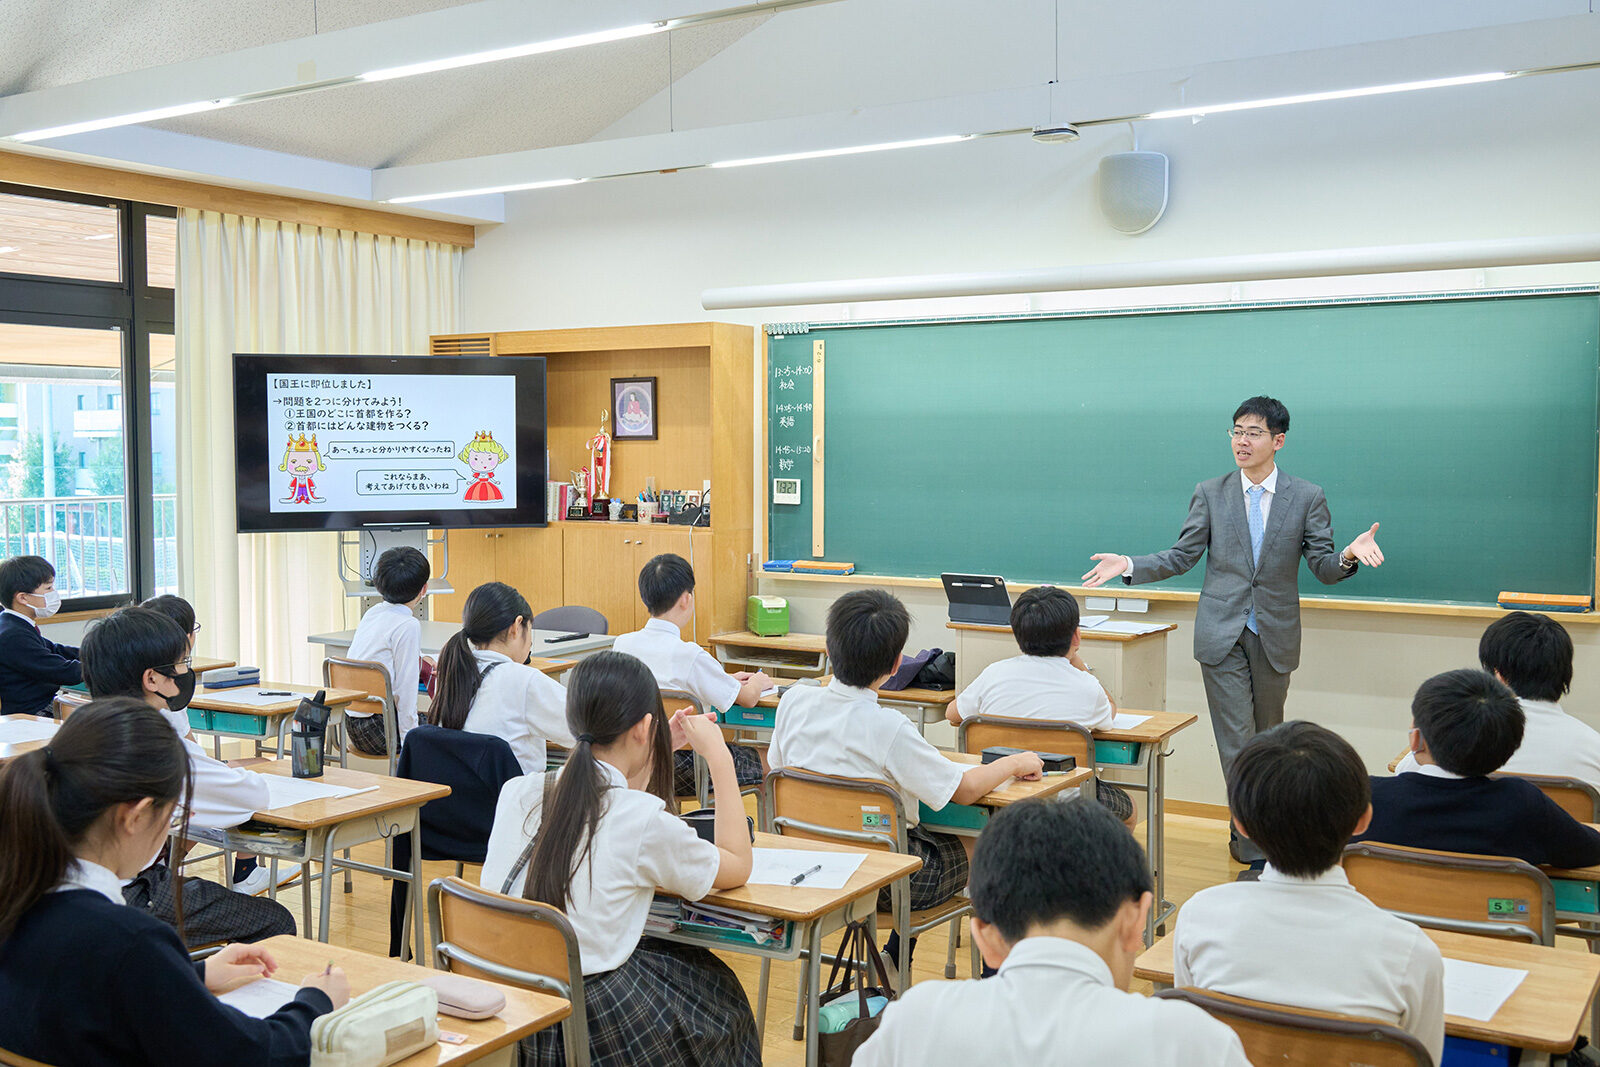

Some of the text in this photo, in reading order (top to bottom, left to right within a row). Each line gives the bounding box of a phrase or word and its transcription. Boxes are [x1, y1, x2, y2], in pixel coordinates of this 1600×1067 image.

[273, 378, 372, 389] 【国王に即位しました】
[779, 379, 795, 390] 社会
[284, 408, 412, 419] ①王国のどこに首都を作る?
[285, 420, 429, 431] ②首都にはどんな建物をつくる?
[779, 416, 795, 428] 英語
[779, 458, 794, 471] 数学
[383, 472, 431, 481] これならまあ、
[366, 482, 450, 491] 考えてあげても良いわね
[866, 816, 872, 824] 5
[1494, 902, 1503, 911] 5
